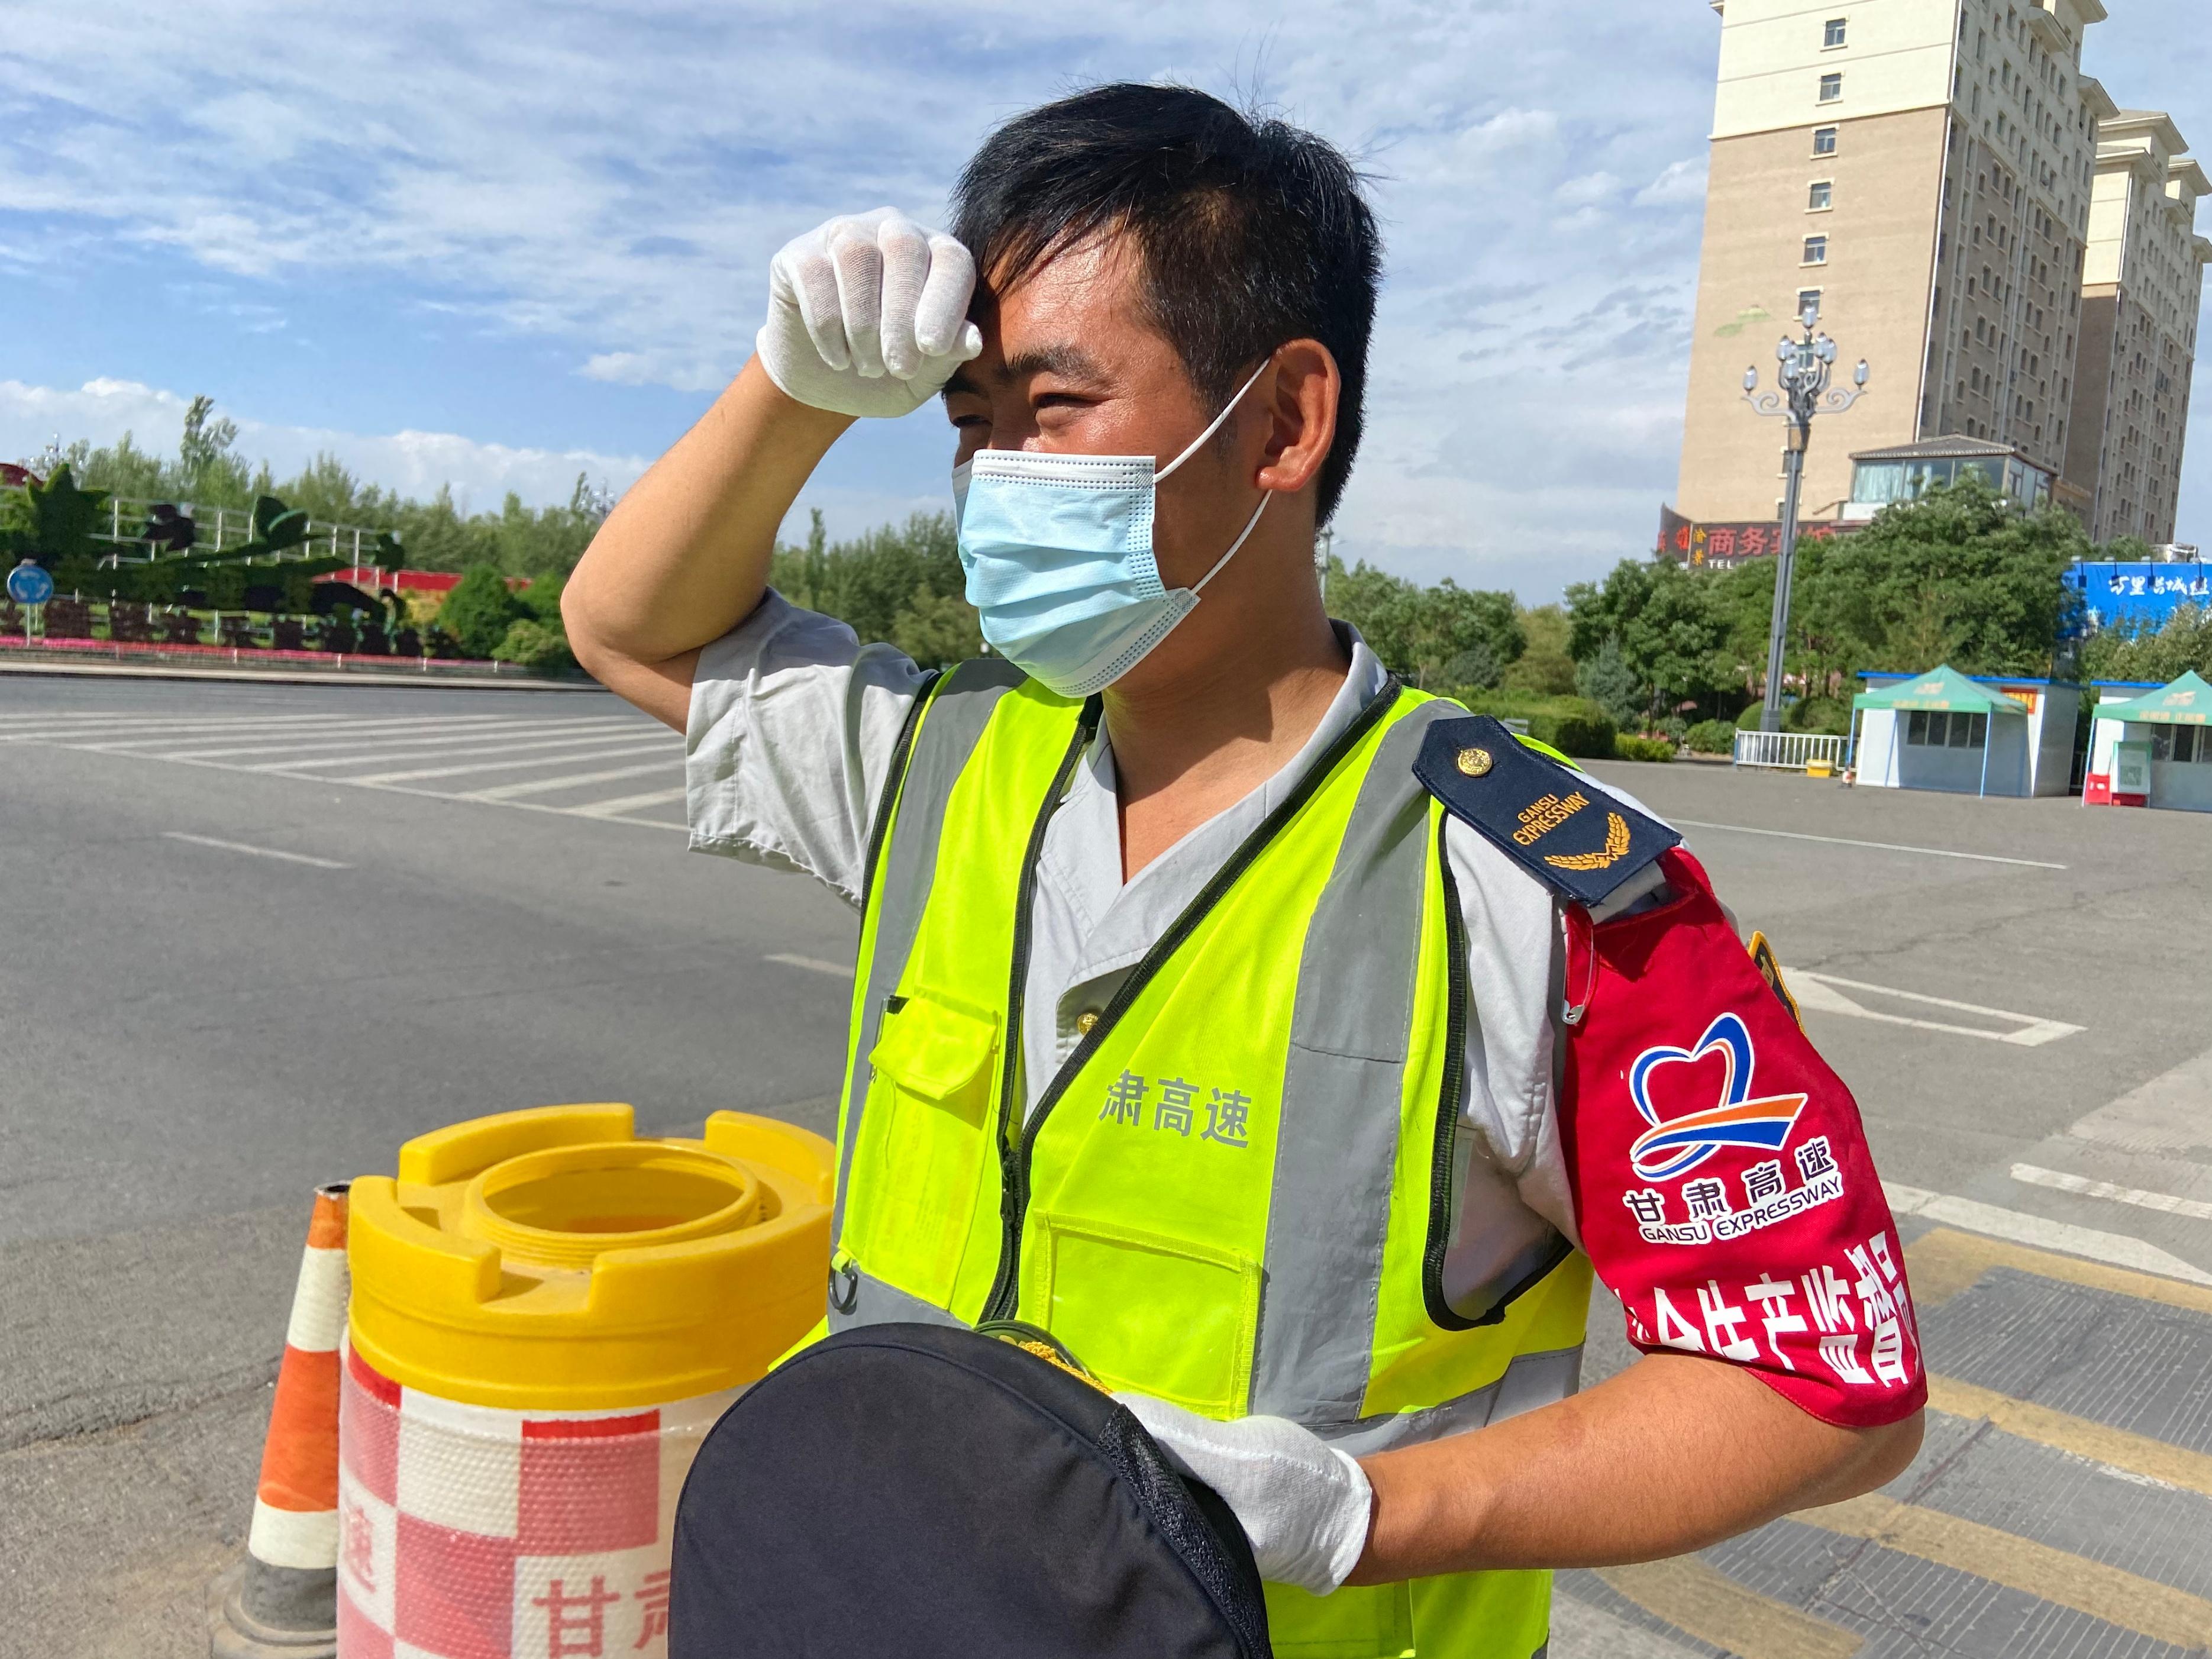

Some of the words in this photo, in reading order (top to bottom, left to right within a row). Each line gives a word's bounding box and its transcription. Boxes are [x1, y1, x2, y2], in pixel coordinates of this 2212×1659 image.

[1512, 790, 1591, 847] EXPRESSWAY
[1517, 793, 1560, 824] GANSU
[1099, 1069, 1252, 1149] 肃高速
[1626, 1140, 1835, 1224] 甘肃高速
[1642, 1225, 1708, 1241] GANSU
[1716, 1176, 1842, 1237] EXPRESSWAY
